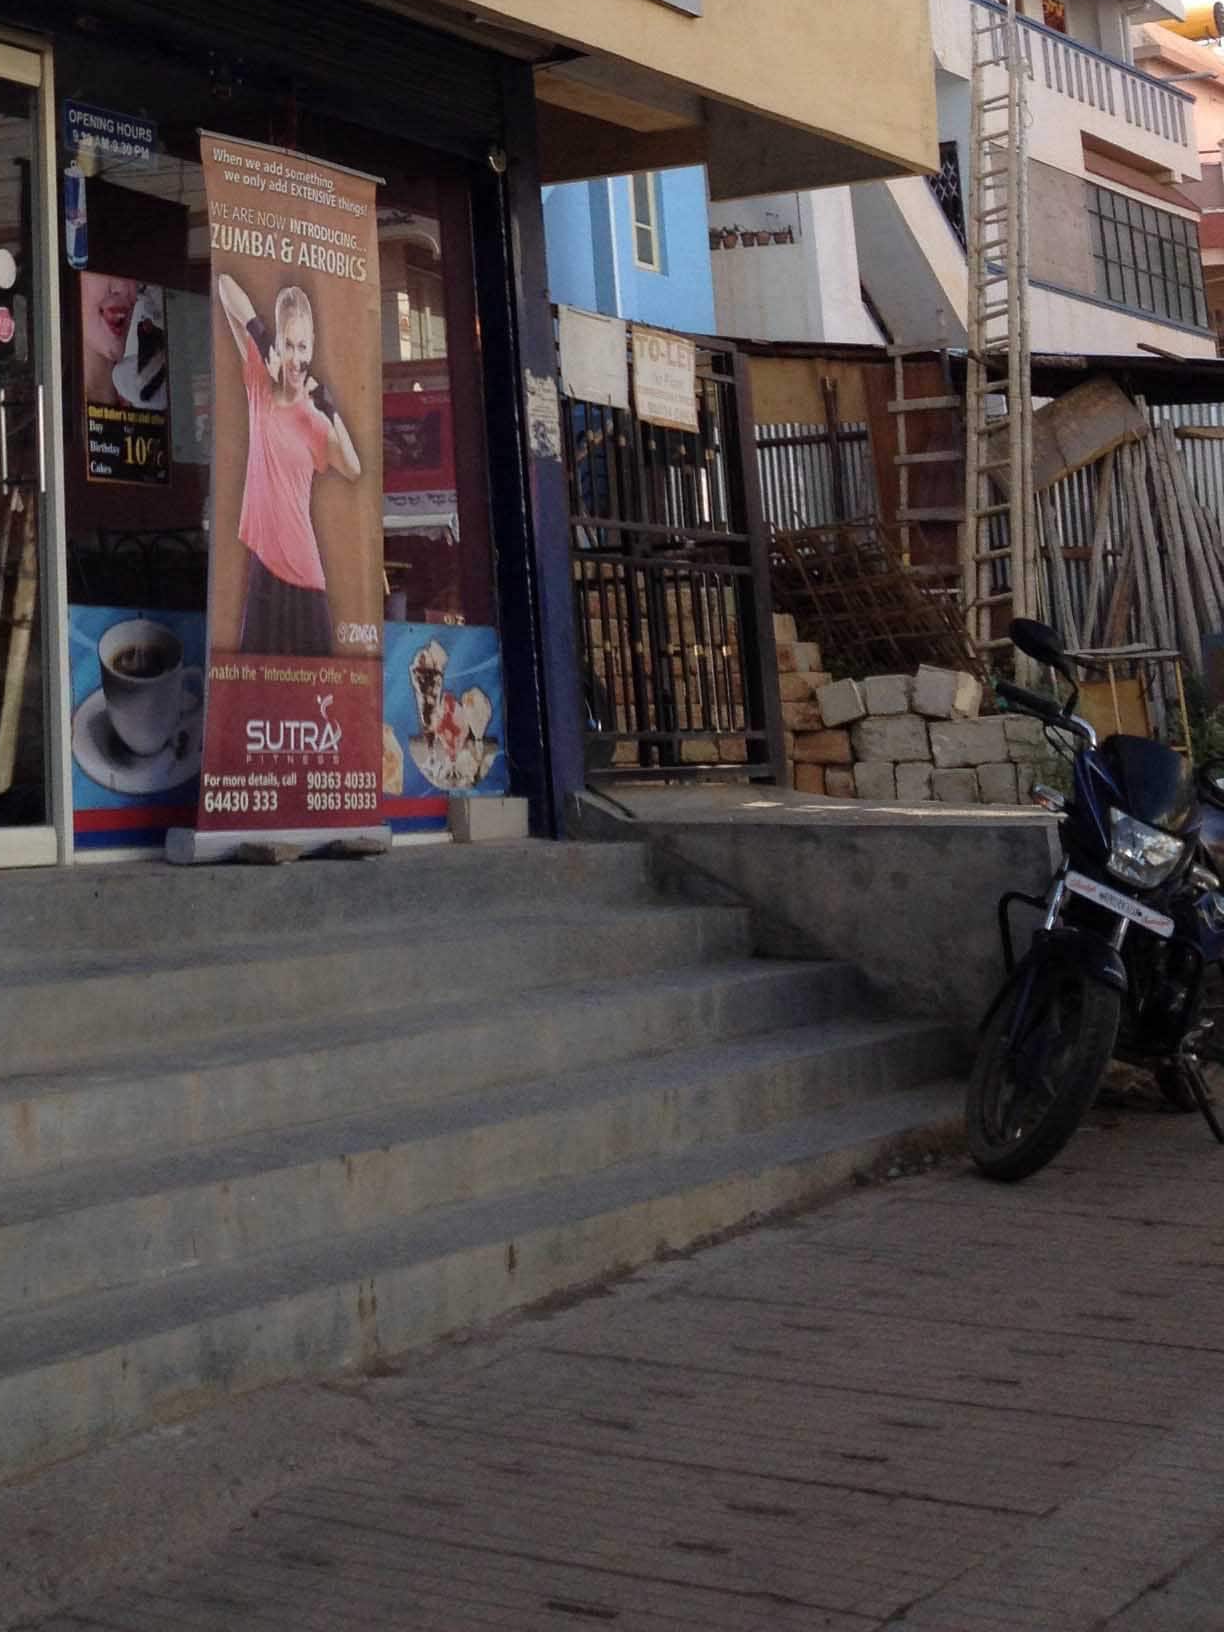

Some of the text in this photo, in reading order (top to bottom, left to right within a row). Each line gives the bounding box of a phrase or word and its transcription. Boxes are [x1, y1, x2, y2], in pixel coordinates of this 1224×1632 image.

[69, 109, 152, 143] OPENING HOURS
[213, 147, 335, 192] When we add something,
[224, 170, 368, 217] we only add EXTENSIVE things!
[211, 201, 228, 219] WE
[232, 207, 254, 225] ARE
[257, 211, 287, 231] NOW
[211, 223, 367, 282] ZUMBA & AEROBICS
[89, 419, 103, 434] Buy
[90, 440, 120, 456] Birthday
[90, 460, 112, 474] Cakes
[242, 665, 256, 682] the
[246, 719, 342, 753] SUTRA
[246, 754, 340, 765] FITNESS
[204, 772, 220, 787] For
[223, 774, 246, 787] more
[282, 772, 297, 787] call
[307, 771, 341, 790] 90363
[204, 790, 278, 813] 64430 333
[307, 792, 341, 811] 90363
